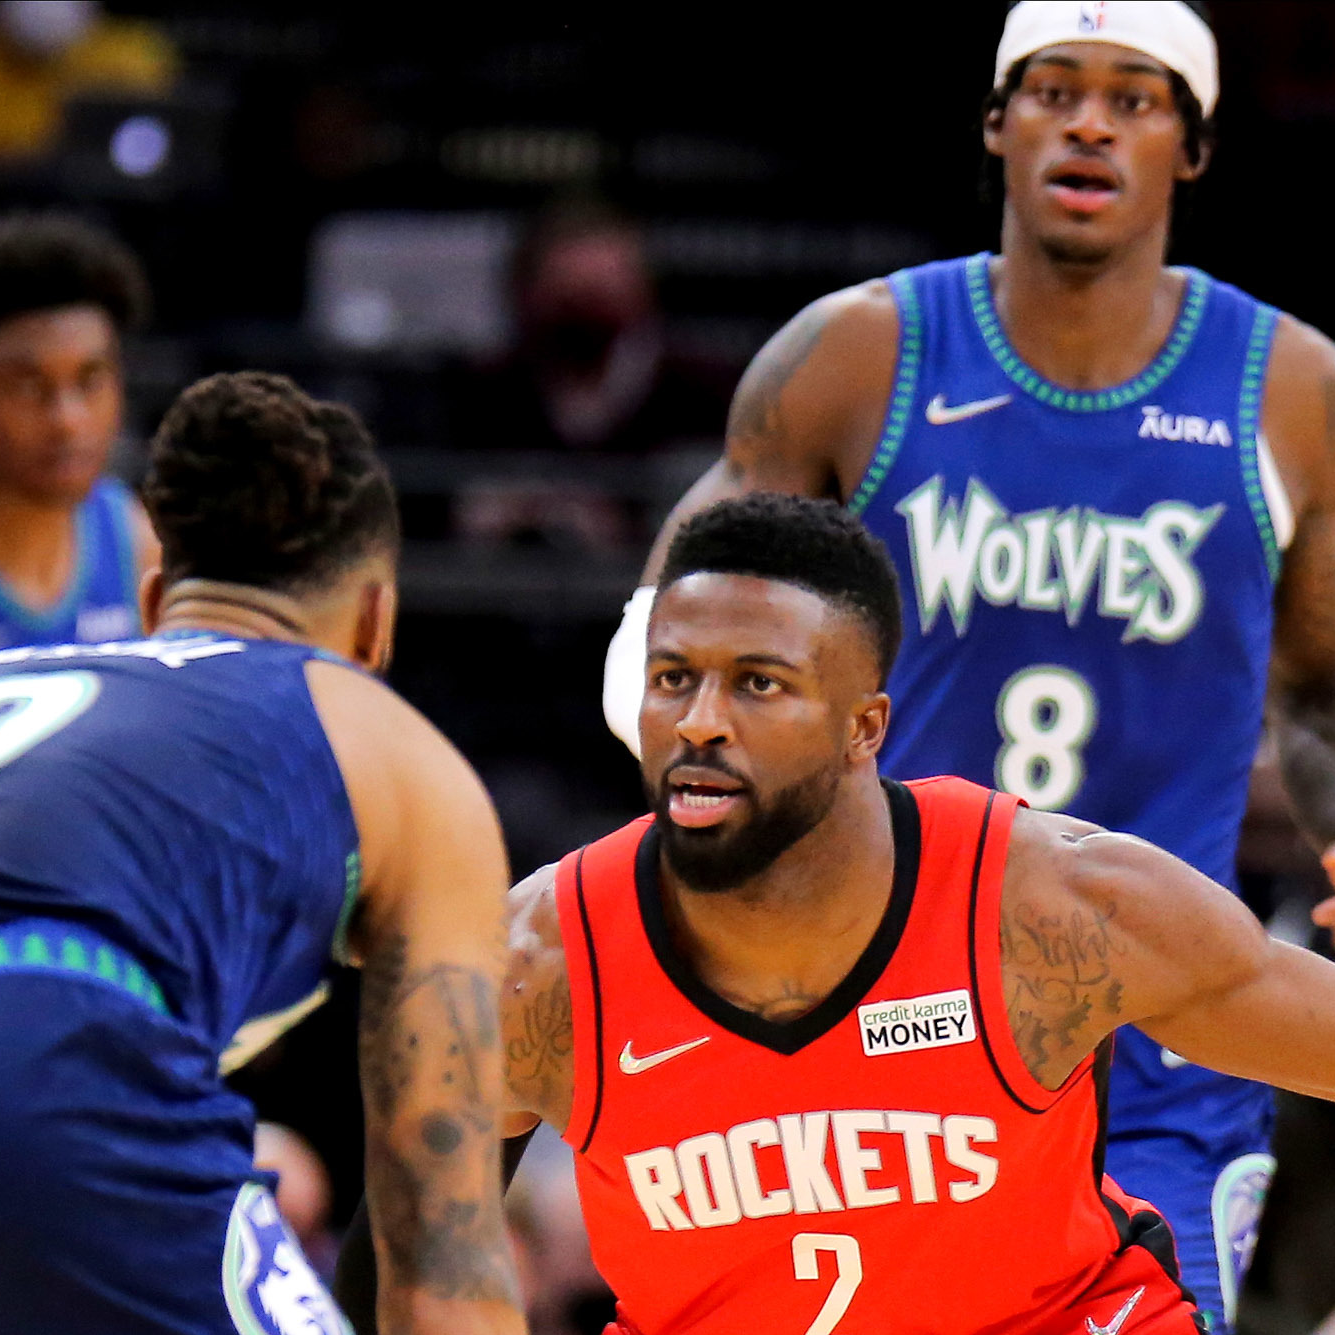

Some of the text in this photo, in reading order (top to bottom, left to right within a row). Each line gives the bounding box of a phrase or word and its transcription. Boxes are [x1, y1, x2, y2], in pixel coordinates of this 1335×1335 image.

[994, 664, 1098, 812] 8
[863, 999, 968, 1026] credit karma
[867, 1013, 968, 1050] MONEY
[623, 1109, 999, 1231] ROCKETS
